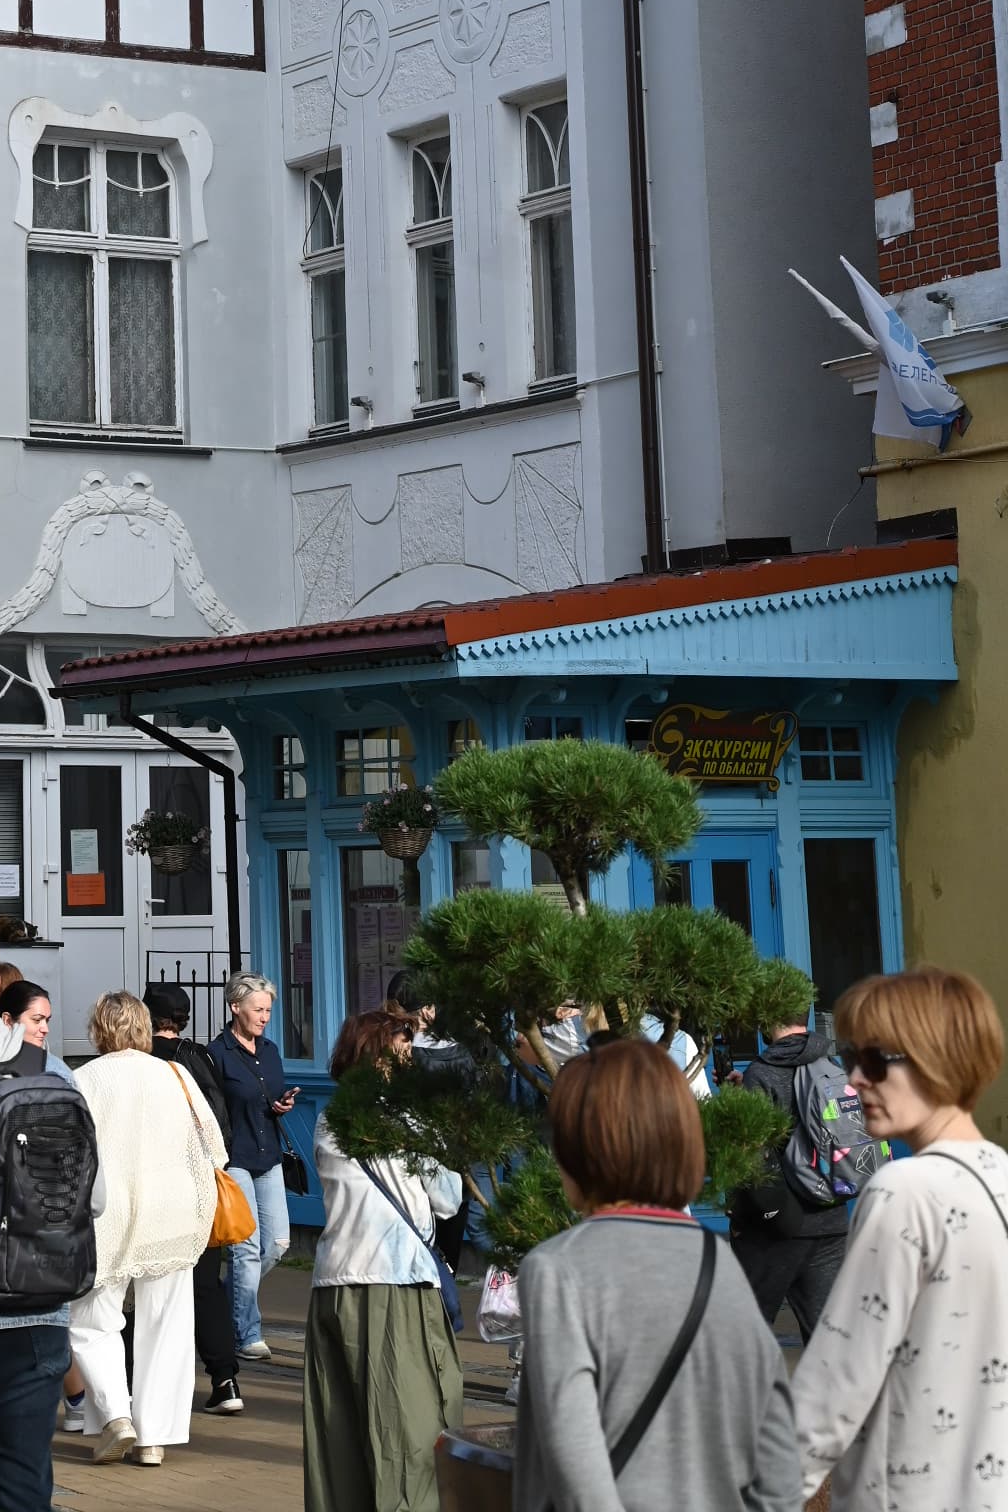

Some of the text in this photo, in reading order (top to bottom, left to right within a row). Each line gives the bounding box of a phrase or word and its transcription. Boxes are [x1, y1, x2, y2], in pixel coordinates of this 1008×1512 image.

[683, 740, 772, 759] ЭКСКУРСИИ
[702, 761, 767, 775] ПО ОБЛАСТИ
